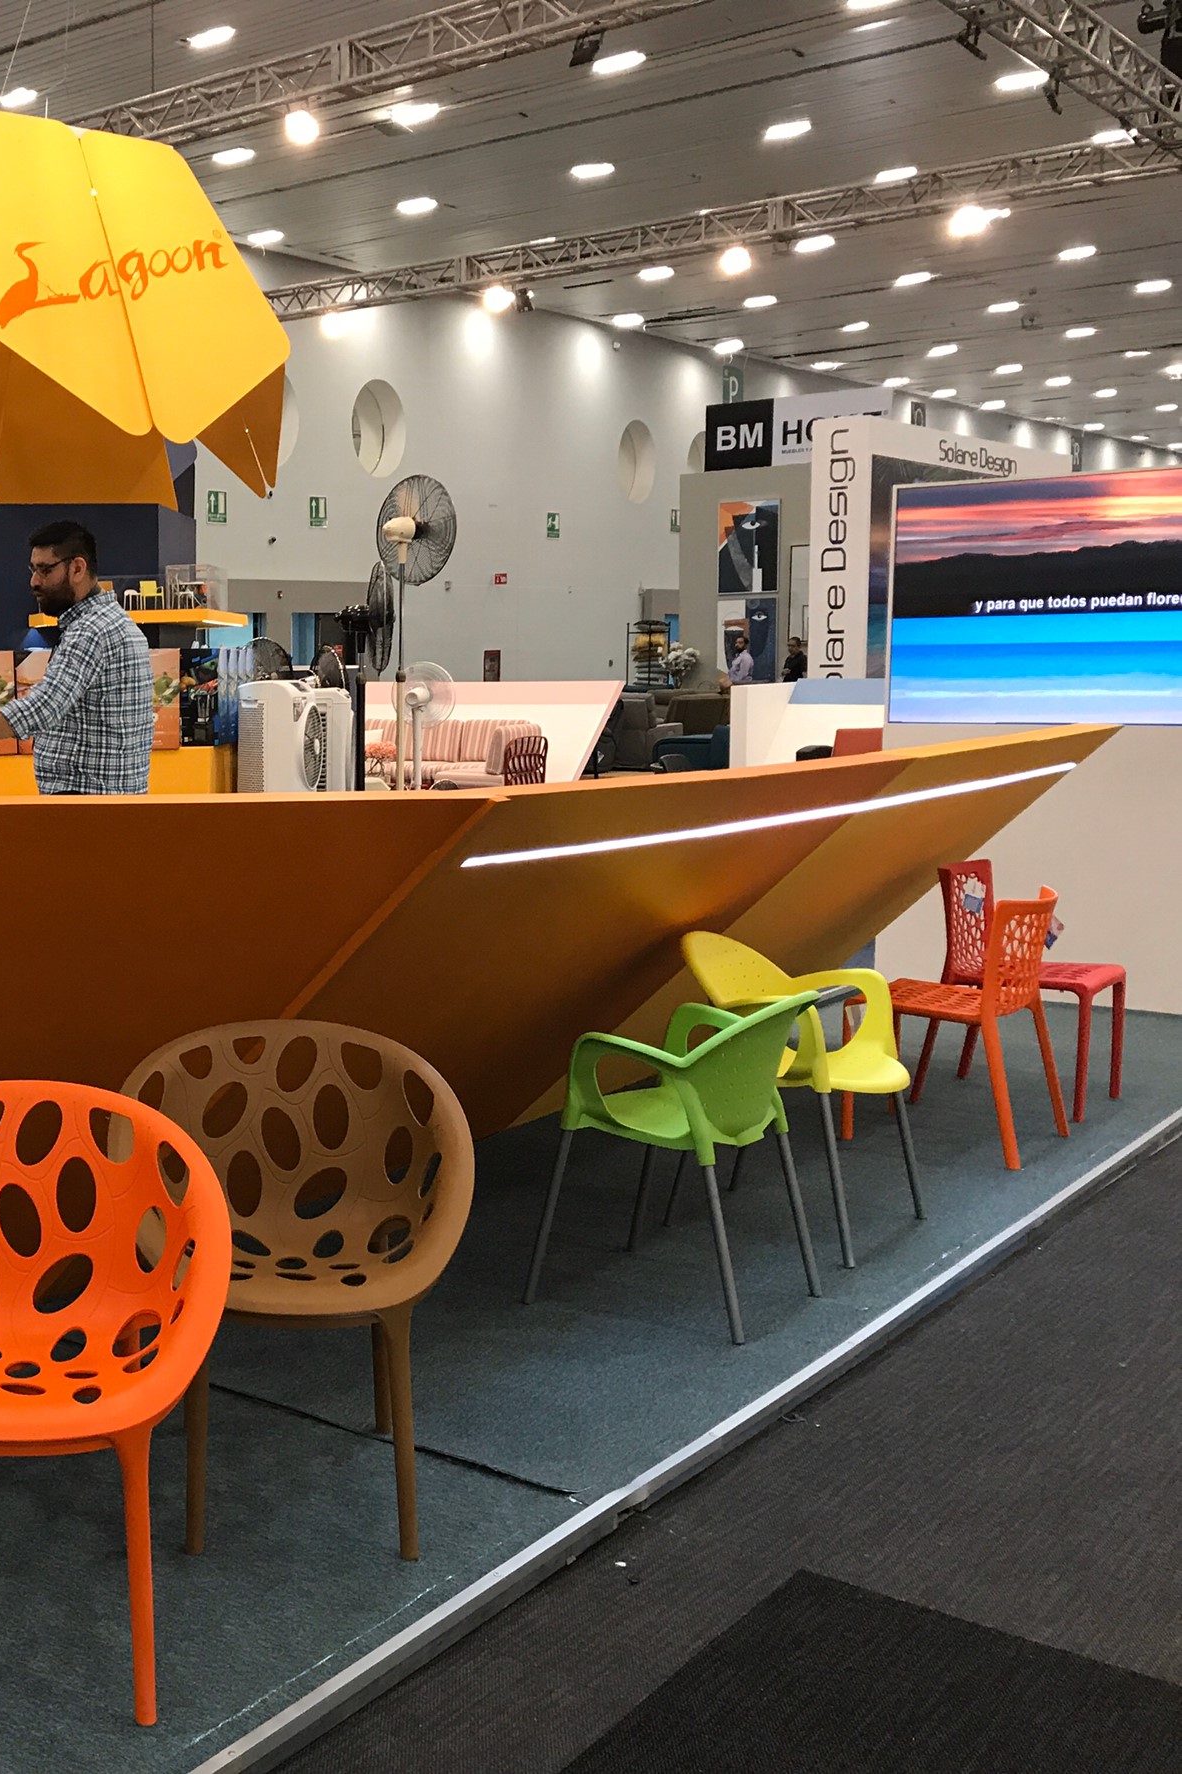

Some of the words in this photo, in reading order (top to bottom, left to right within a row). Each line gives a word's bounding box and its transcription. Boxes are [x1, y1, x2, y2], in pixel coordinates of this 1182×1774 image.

[716, 422, 764, 451] BM
[939, 439, 978, 467] Solare
[979, 447, 1017, 477] Design
[821, 428, 856, 572] Design
[974, 600, 983, 613] y
[986, 599, 1016, 613] para
[1019, 598, 1044, 612] que
[1048, 595, 1086, 608] todos
[1090, 593, 1143, 610] puedan
